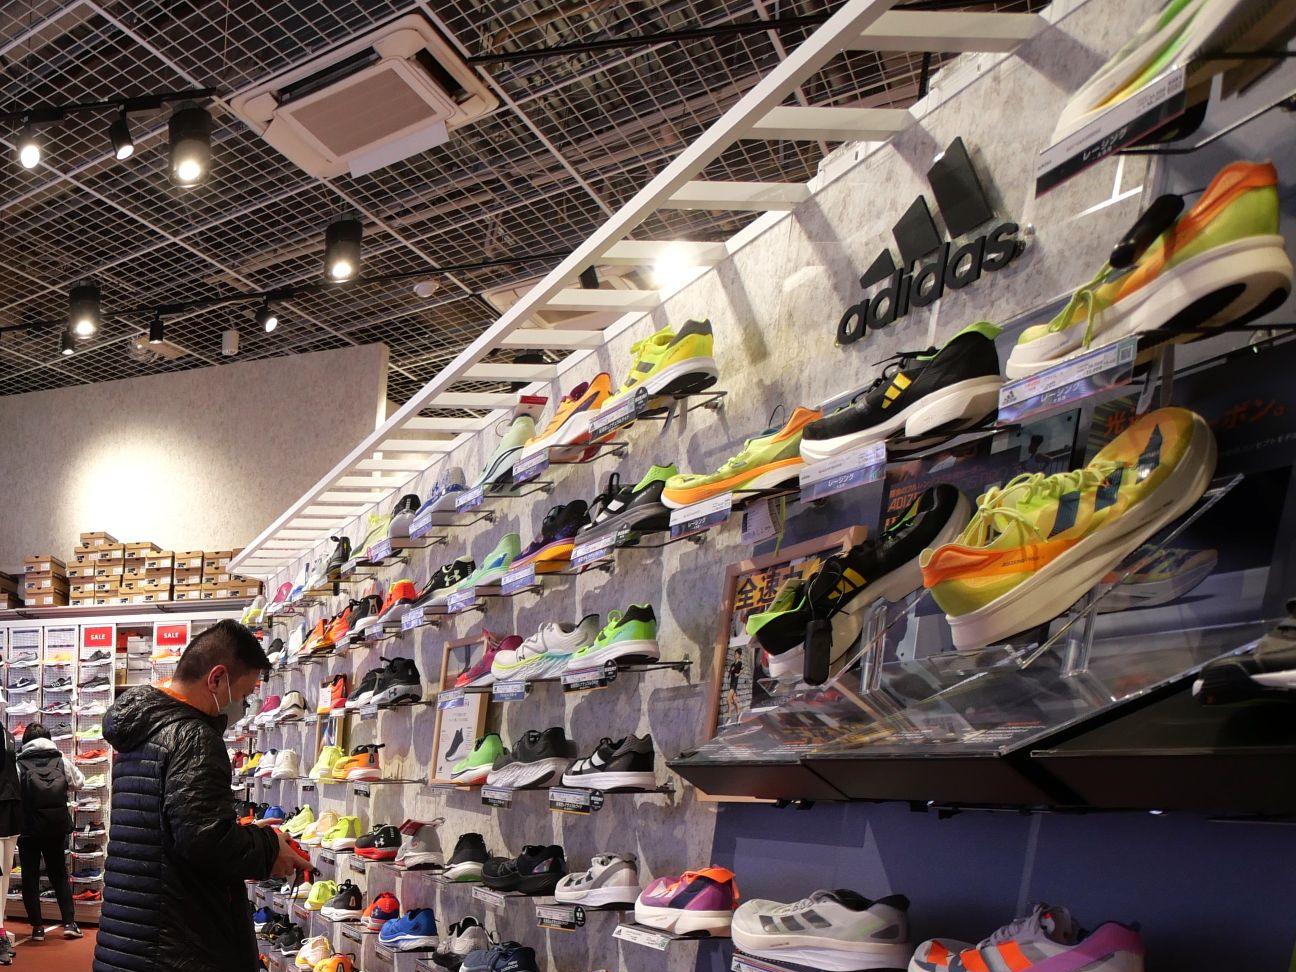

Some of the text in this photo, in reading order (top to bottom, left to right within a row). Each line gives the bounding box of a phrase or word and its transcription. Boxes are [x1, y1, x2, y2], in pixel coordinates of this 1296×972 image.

[837, 222, 1020, 345] adidas
[827, 473, 855, 487] レーシング
